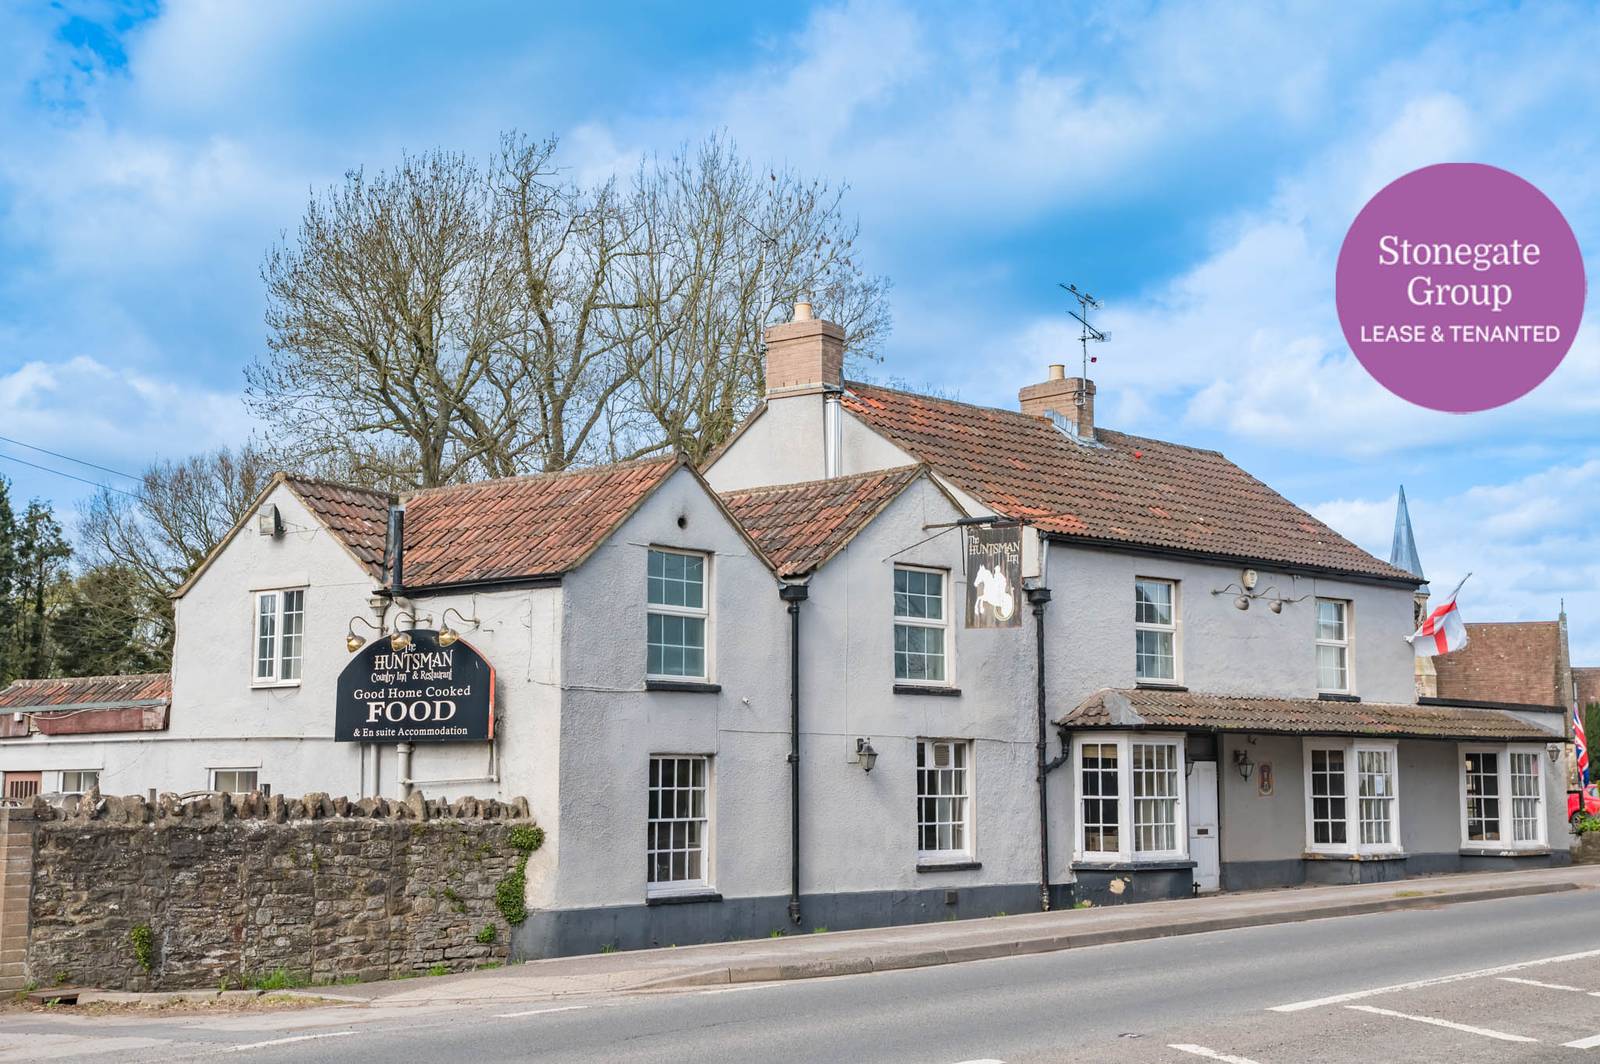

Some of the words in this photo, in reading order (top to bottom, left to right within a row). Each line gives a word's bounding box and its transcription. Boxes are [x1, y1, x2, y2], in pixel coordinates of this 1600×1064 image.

[968, 535, 980, 545] The
[969, 541, 1020, 556] HUNTSMAN
[1007, 553, 1019, 565] Inn
[374, 649, 454, 673] HUNTSMAN
[371, 672, 395, 685] Country
[396, 671, 407, 683] Inn
[412, 671, 419, 680] &
[420, 669, 453, 681] Restaurant
[353, 688, 385, 700] Good
[388, 687, 422, 699] Home
[426, 685, 471, 697] Cooked
[365, 700, 457, 723] FOOD
[353, 729, 361, 737] &
[363, 728, 374, 737] En
[375, 727, 396, 737] suite
[398, 726, 468, 736] Accommodation
